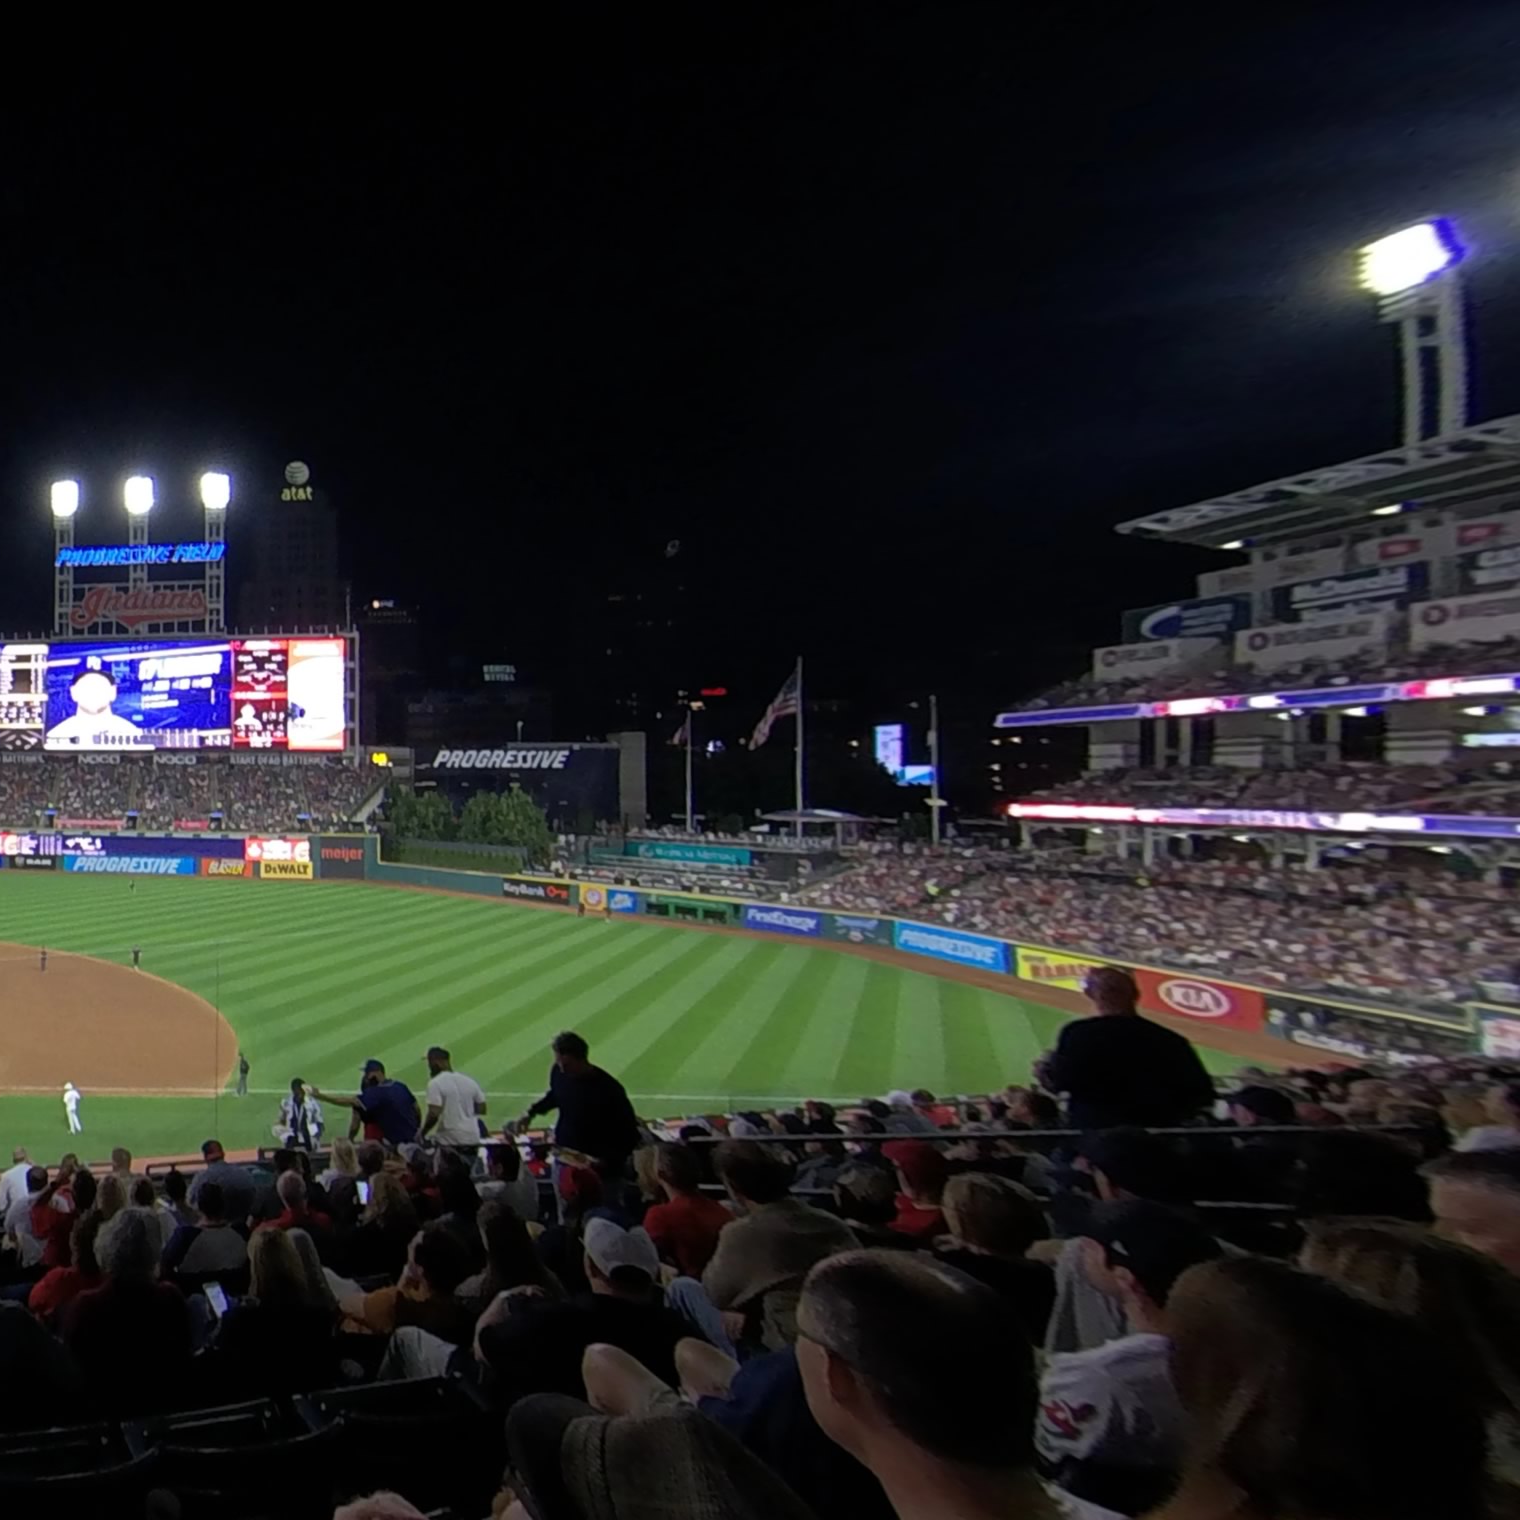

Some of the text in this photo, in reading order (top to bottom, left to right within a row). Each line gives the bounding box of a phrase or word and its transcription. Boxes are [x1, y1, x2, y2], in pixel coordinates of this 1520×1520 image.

[55, 541, 225, 567] PROGRESSIVE FIELD
[69, 585, 207, 629] Indians
[78, 753, 121, 765] NOCO
[153, 753, 196, 766] NOCO
[433, 749, 570, 769] PROGRESSIVE
[321, 847, 364, 863] meijer
[73, 856, 181, 874] PROGRESSIVE
[503, 879, 545, 897] KeyBank
[747, 908, 817, 932] FirstEnergy
[1170, 985, 1218, 1012] KIA
